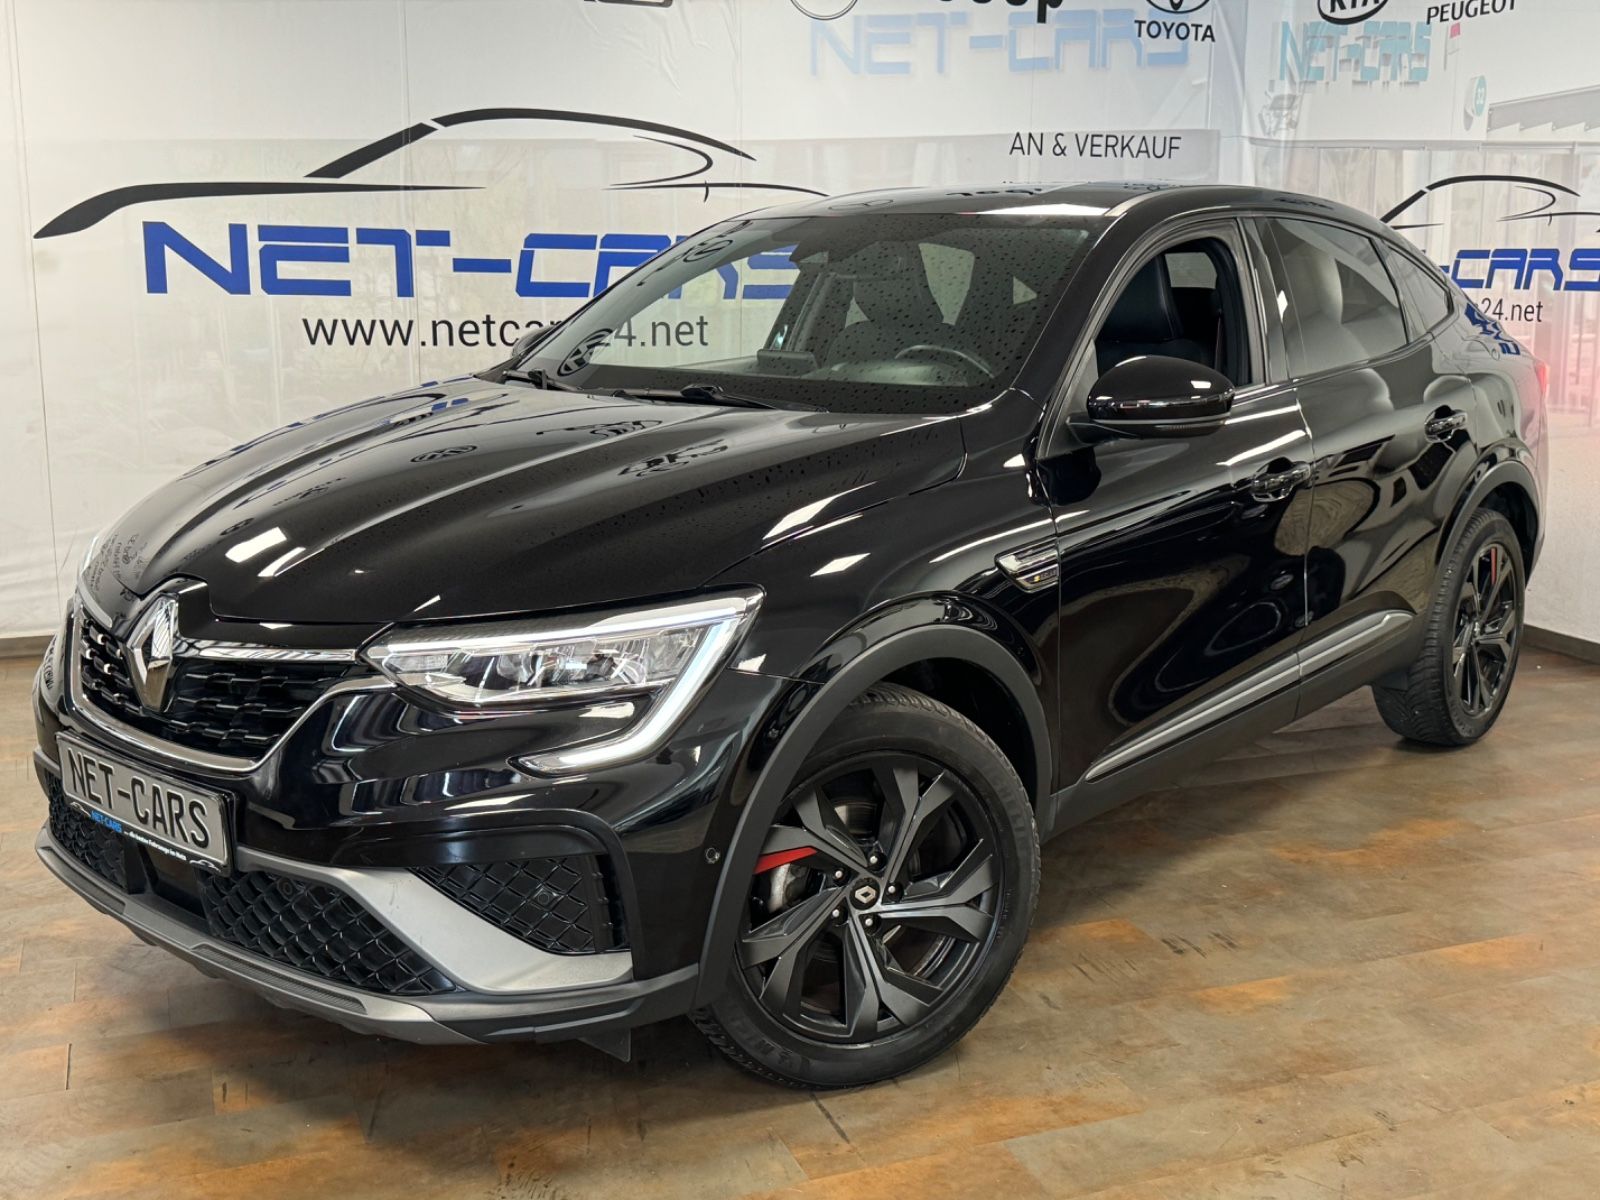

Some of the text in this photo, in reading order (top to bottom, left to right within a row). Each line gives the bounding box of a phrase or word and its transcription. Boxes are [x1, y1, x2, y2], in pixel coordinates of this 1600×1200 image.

[811, 9, 1189, 76] NET-CARS
[1134, 20, 1216, 43] TOYOTA
[1010, 132, 1182, 160] AN & VERKAUF
[68, 748, 210, 849] NET-CARS
